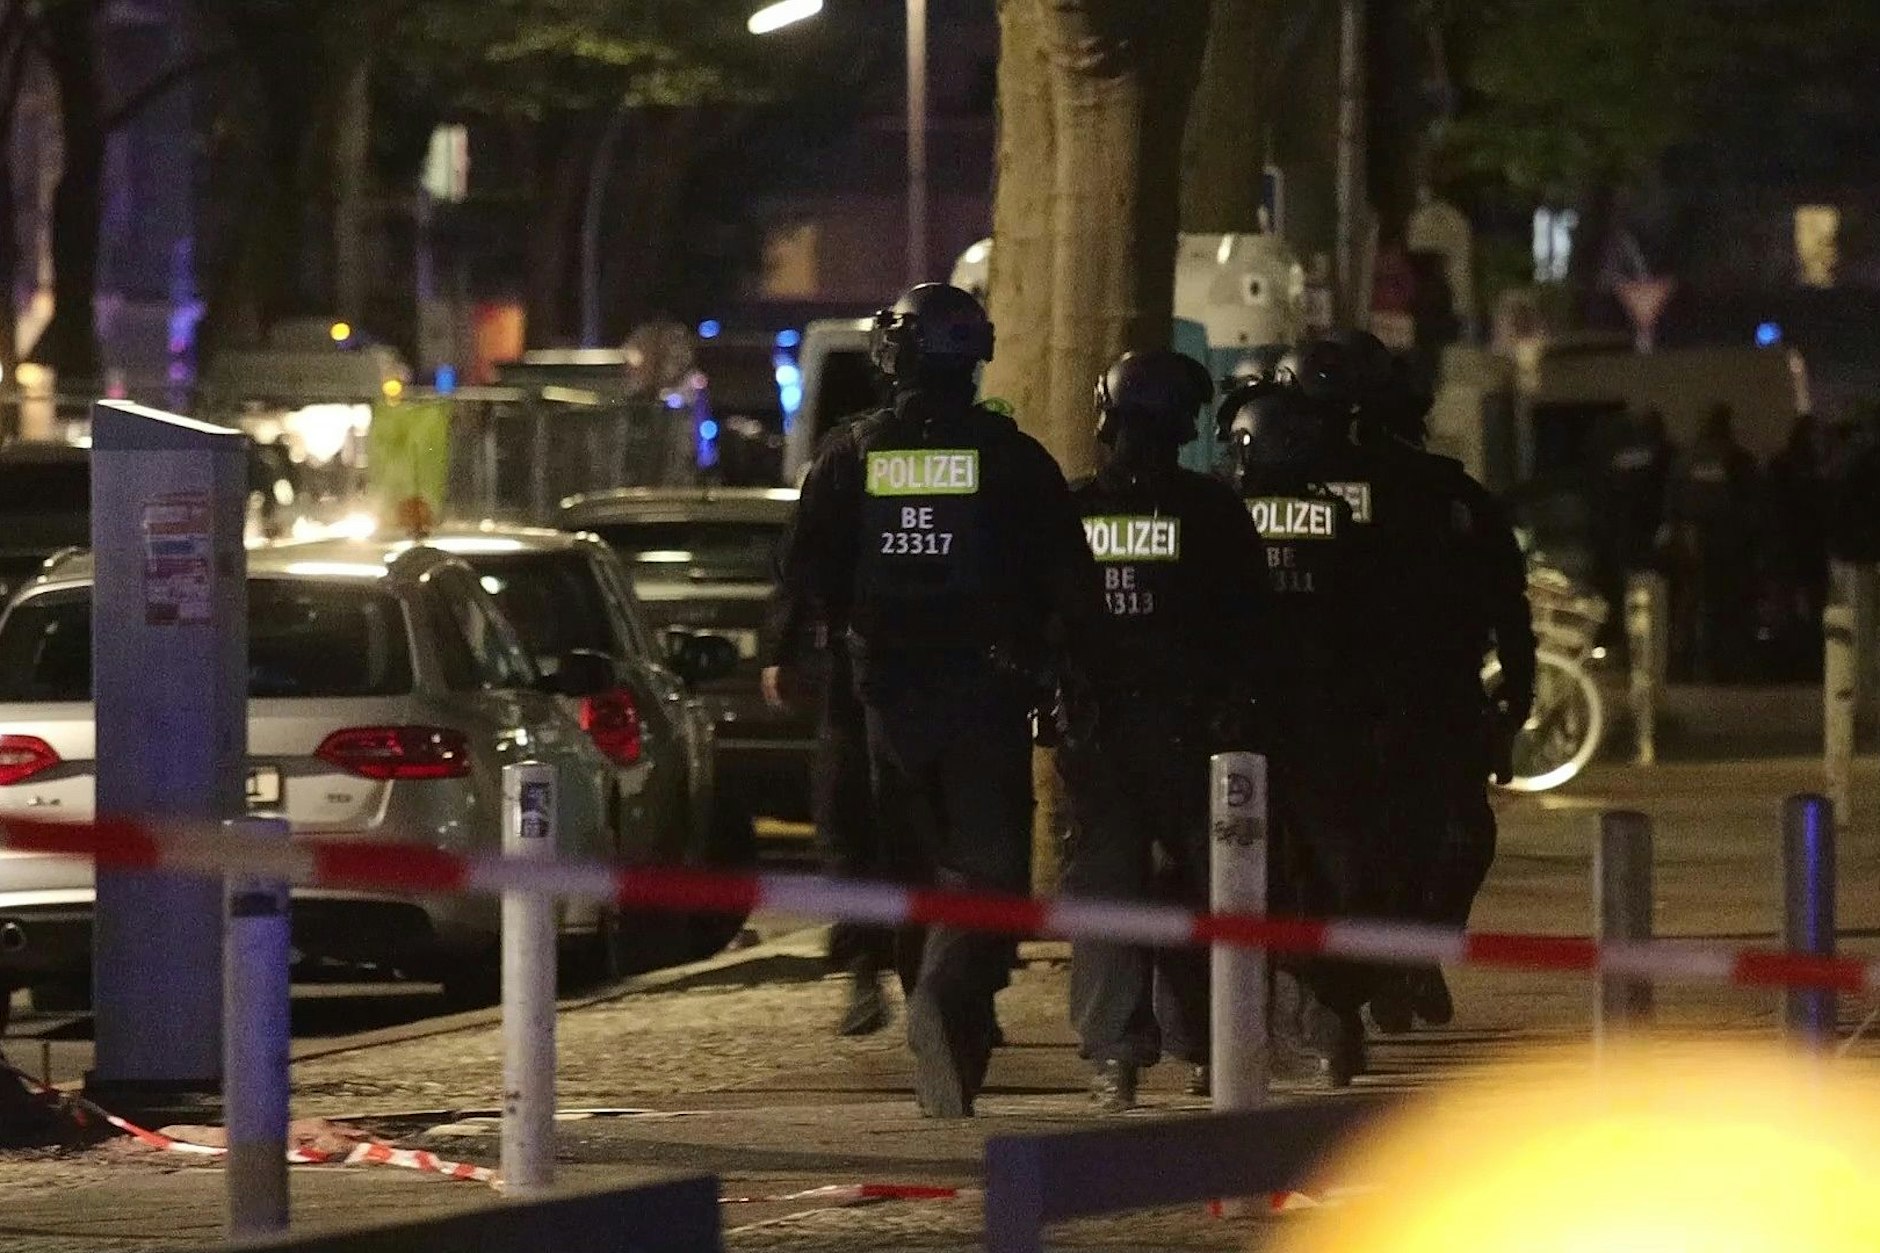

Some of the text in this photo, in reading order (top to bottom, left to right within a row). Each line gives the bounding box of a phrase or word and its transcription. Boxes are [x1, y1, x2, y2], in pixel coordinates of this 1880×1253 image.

[872, 454, 975, 489] POLIZEI
[901, 506, 935, 529] BE
[1250, 499, 1333, 535] OLIZEI
[881, 532, 953, 554] 23317
[1105, 566, 1137, 590] BE
[1105, 592, 1155, 615] 313
